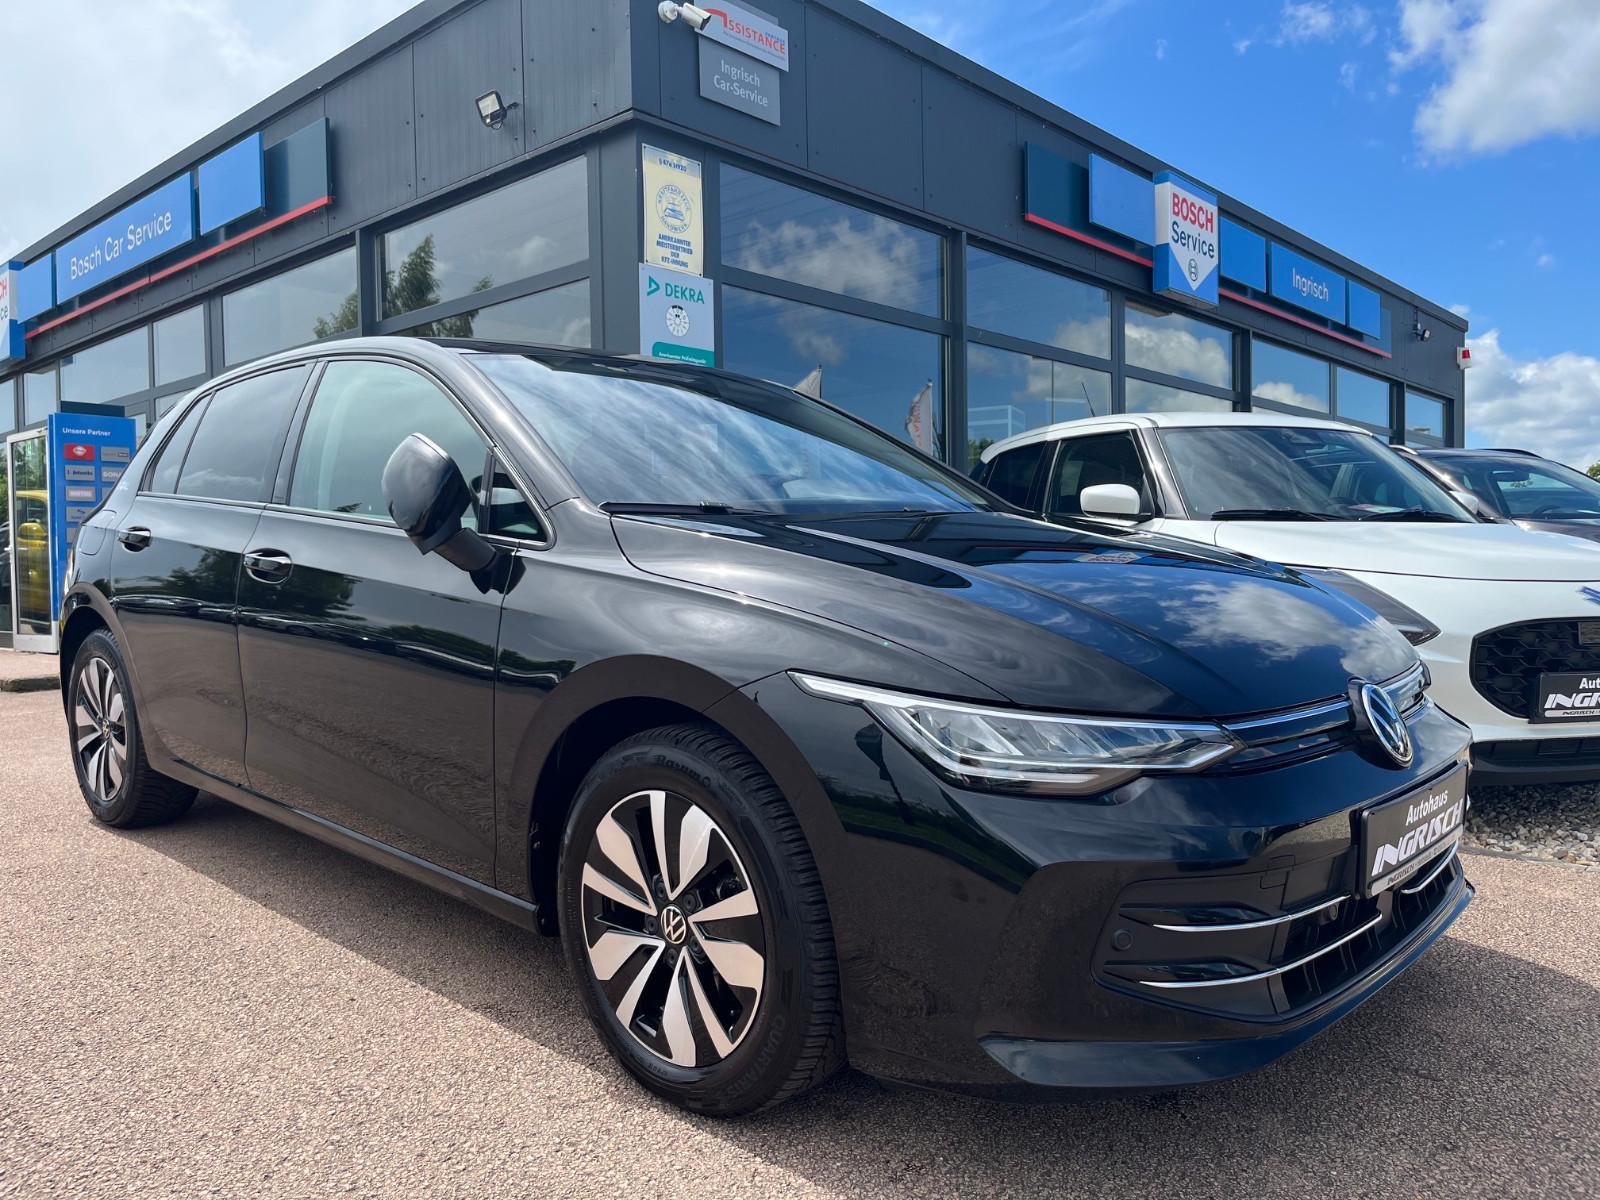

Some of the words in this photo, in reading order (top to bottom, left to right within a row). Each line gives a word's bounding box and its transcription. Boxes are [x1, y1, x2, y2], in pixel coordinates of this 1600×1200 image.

[713, 75, 769, 107] Car-Service
[721, 59, 761, 87] Ingrisch
[1172, 193, 1214, 233] BOSCH
[70, 247, 101, 280] Bosch
[105, 237, 124, 262] Car
[127, 211, 172, 250] Service
[1171, 221, 1215, 259] Service
[665, 282, 705, 305] DEKRA
[1292, 267, 1329, 302] Ingrisch
[62, 427, 86, 435] Unsere
[87, 428, 111, 437] Partner
[1405, 790, 1449, 827] Autohaus
[1371, 798, 1464, 877] INGRISCH
